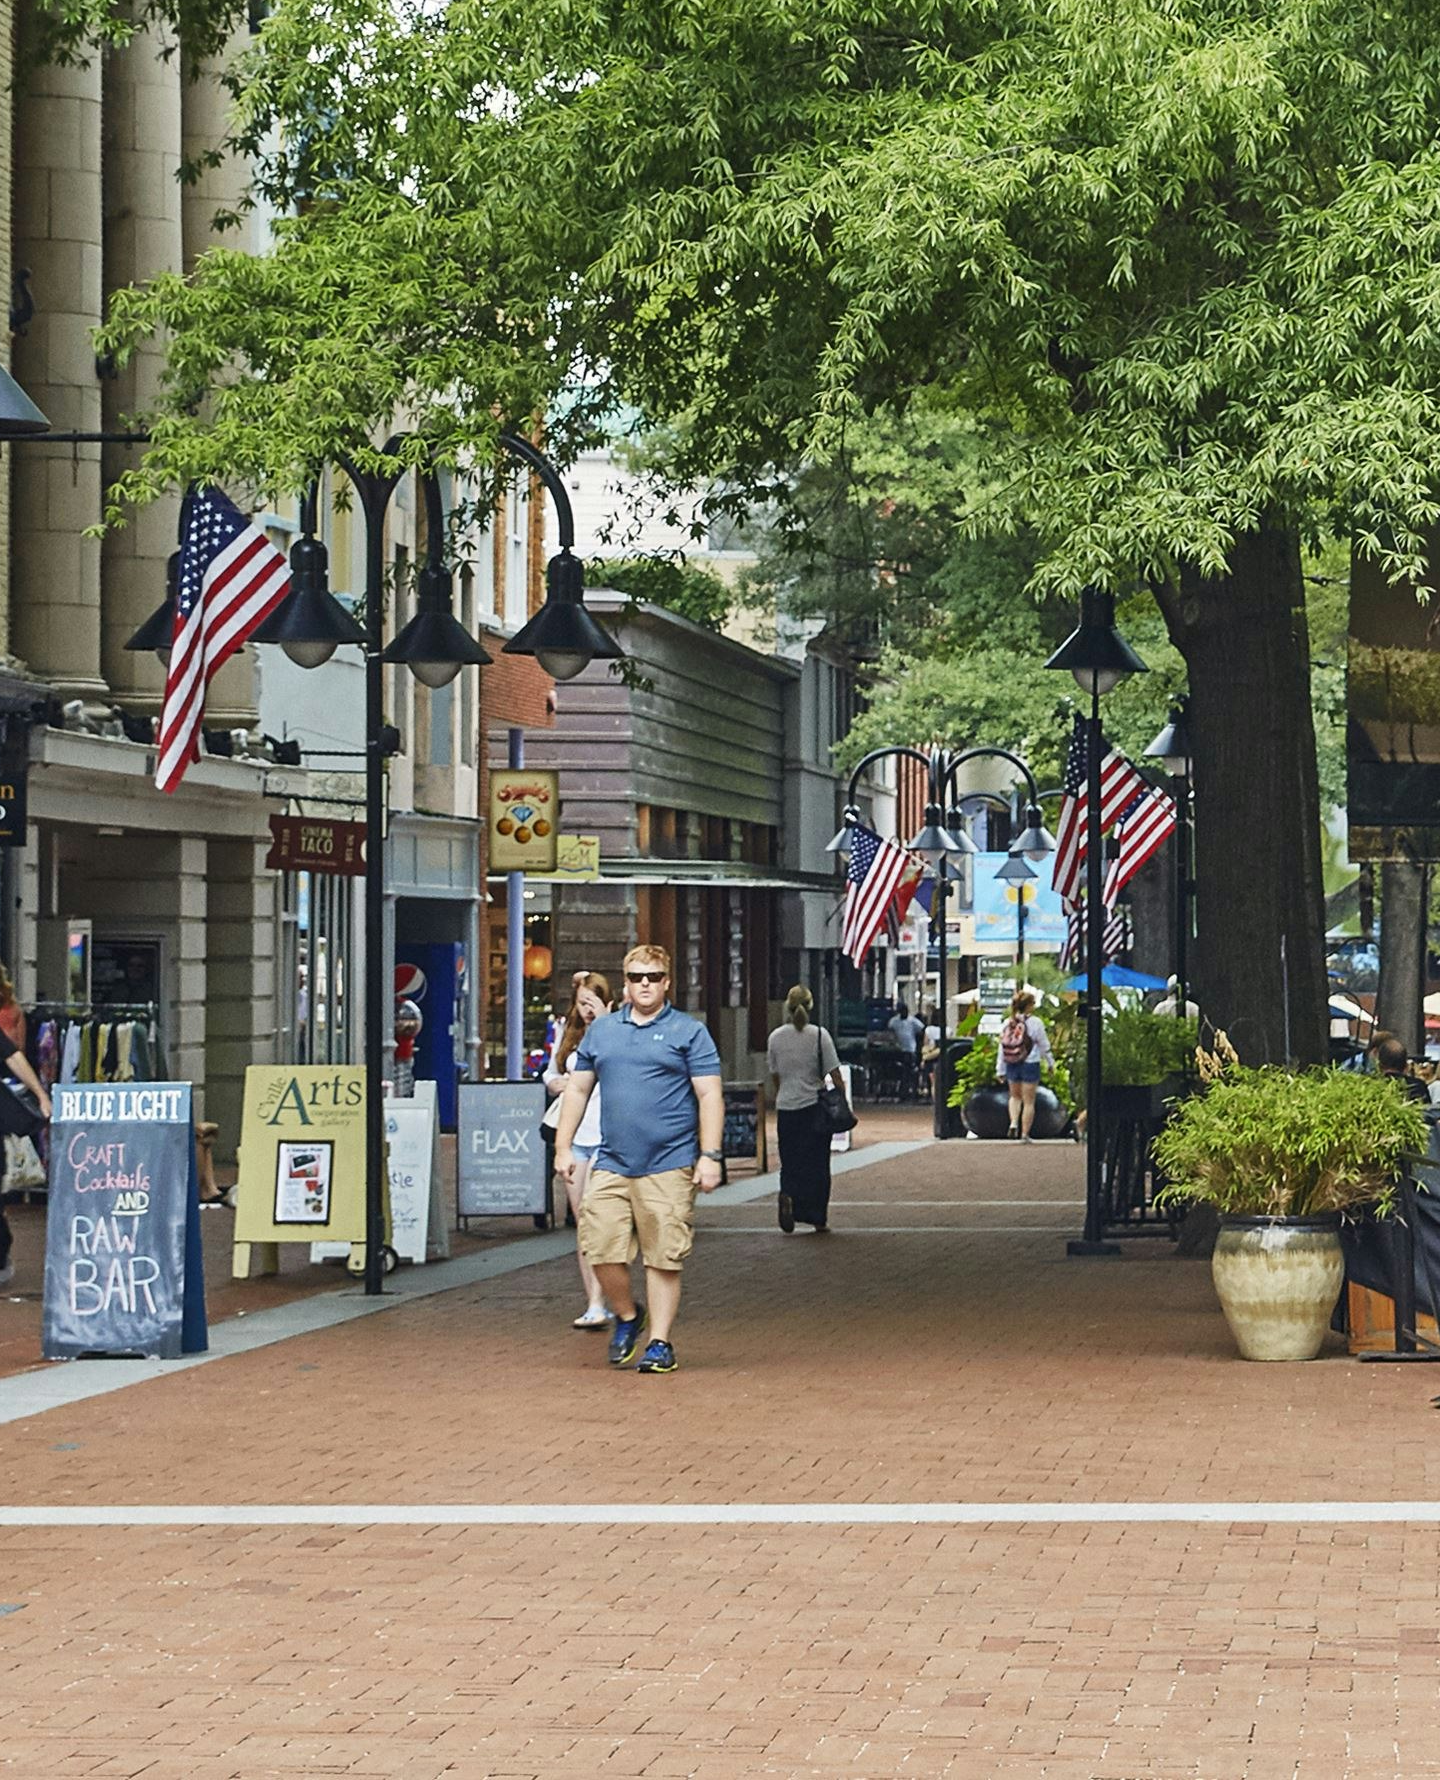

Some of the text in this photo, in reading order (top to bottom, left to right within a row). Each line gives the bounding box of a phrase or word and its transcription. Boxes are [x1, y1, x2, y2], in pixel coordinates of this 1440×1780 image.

[300, 837, 334, 854] TACO
[60, 1090, 182, 1121] BLUE LIGHT
[266, 1075, 363, 1126] Arts
[471, 1129, 530, 1154] FLAX
[74, 1163, 151, 1193] Cocktails
[113, 1192, 150, 1210] AND
[70, 1215, 140, 1256] RAW
[69, 1256, 160, 1317] BAR
